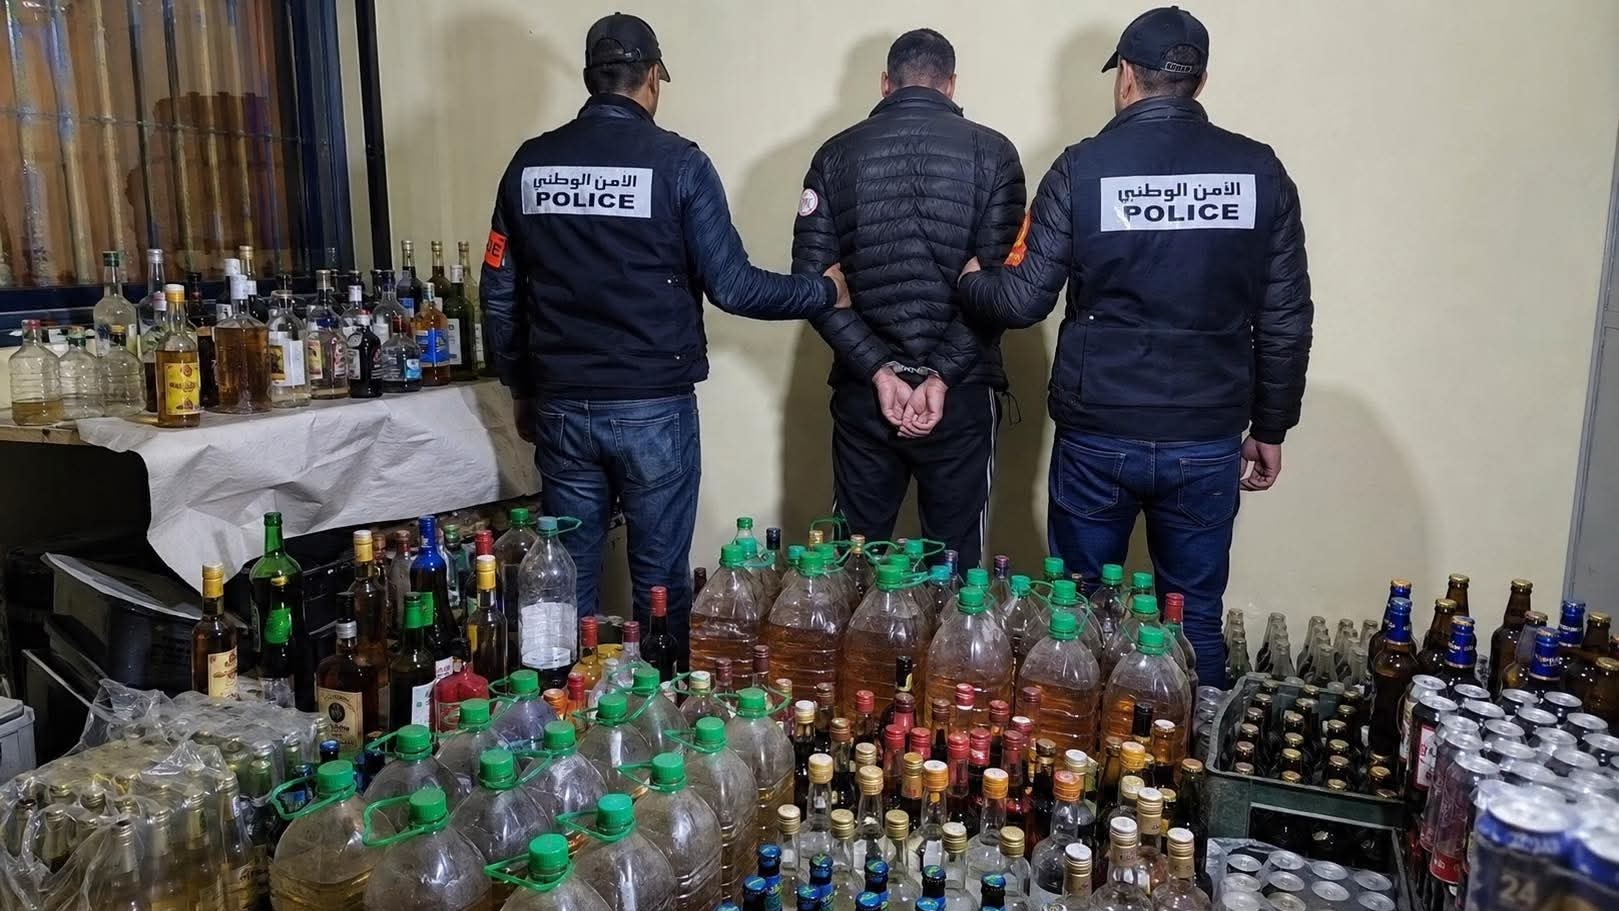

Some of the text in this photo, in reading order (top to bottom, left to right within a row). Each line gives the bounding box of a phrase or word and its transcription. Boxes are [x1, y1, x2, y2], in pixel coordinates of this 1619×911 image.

[533, 172, 591, 191] الوطني
[536, 191, 635, 210] POLICE
[1118, 182, 1188, 203] الوطني
[1123, 203, 1239, 222] POLICE
[1499, 873, 1537, 906] 24
